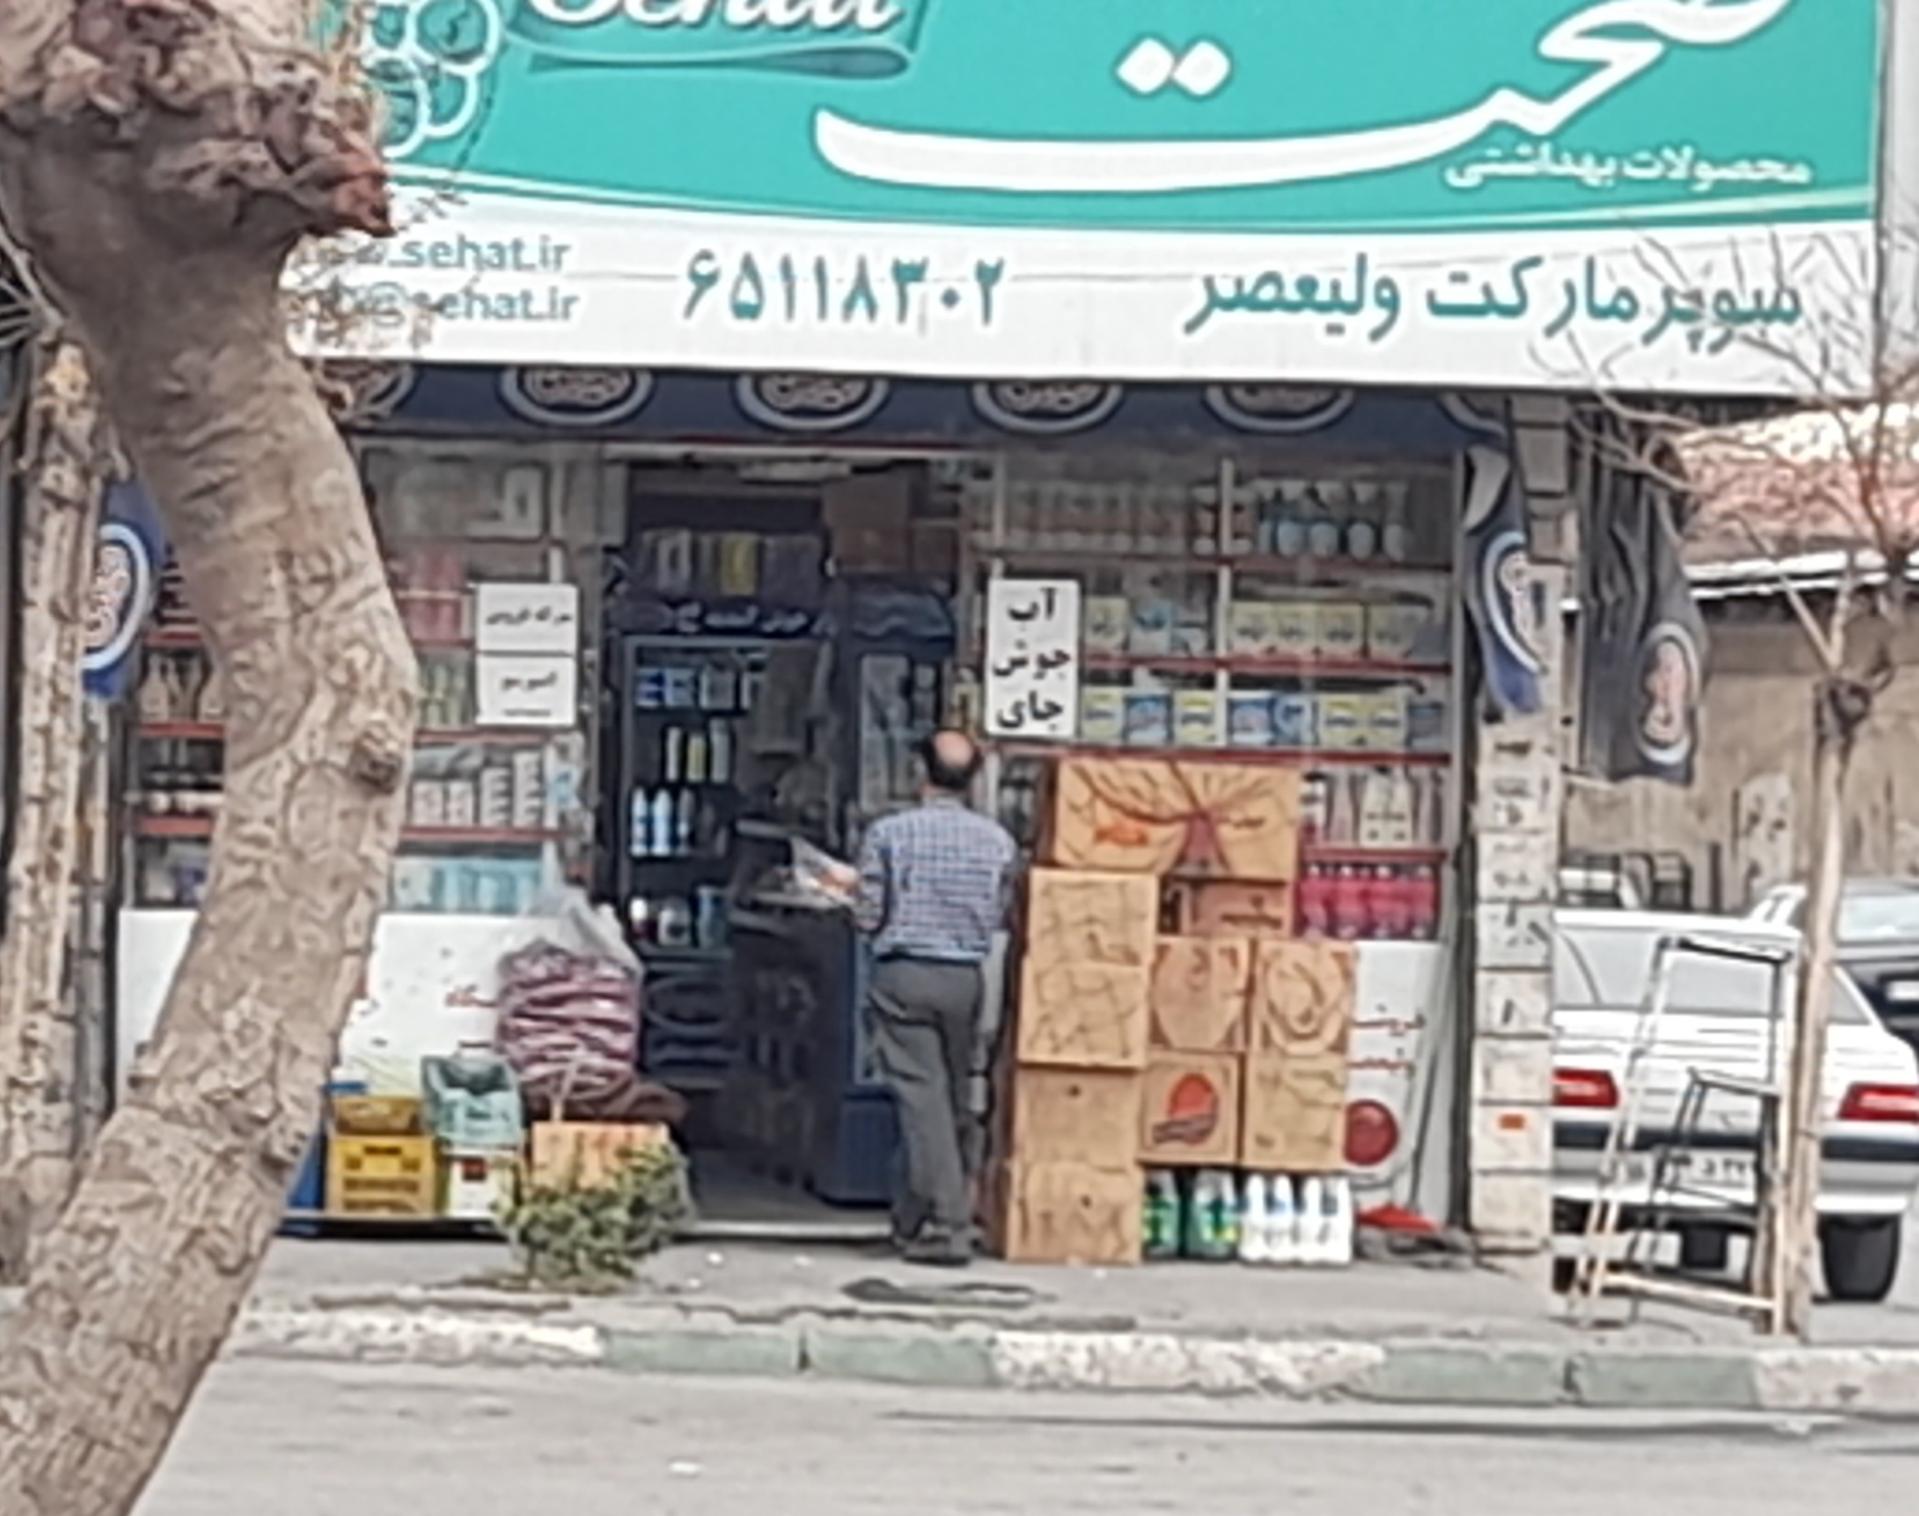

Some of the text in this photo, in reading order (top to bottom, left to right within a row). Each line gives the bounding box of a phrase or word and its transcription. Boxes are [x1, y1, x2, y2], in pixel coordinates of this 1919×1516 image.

[1445, 141, 1813, 191] محصولات بهداشتی
[683, 249, 1005, 326] ۶۵۱۱۸۳۰۲
[1183, 251, 1401, 342] ولیعصر
[1007, 587, 1058, 632] آب
[993, 639, 1071, 680] جوش
